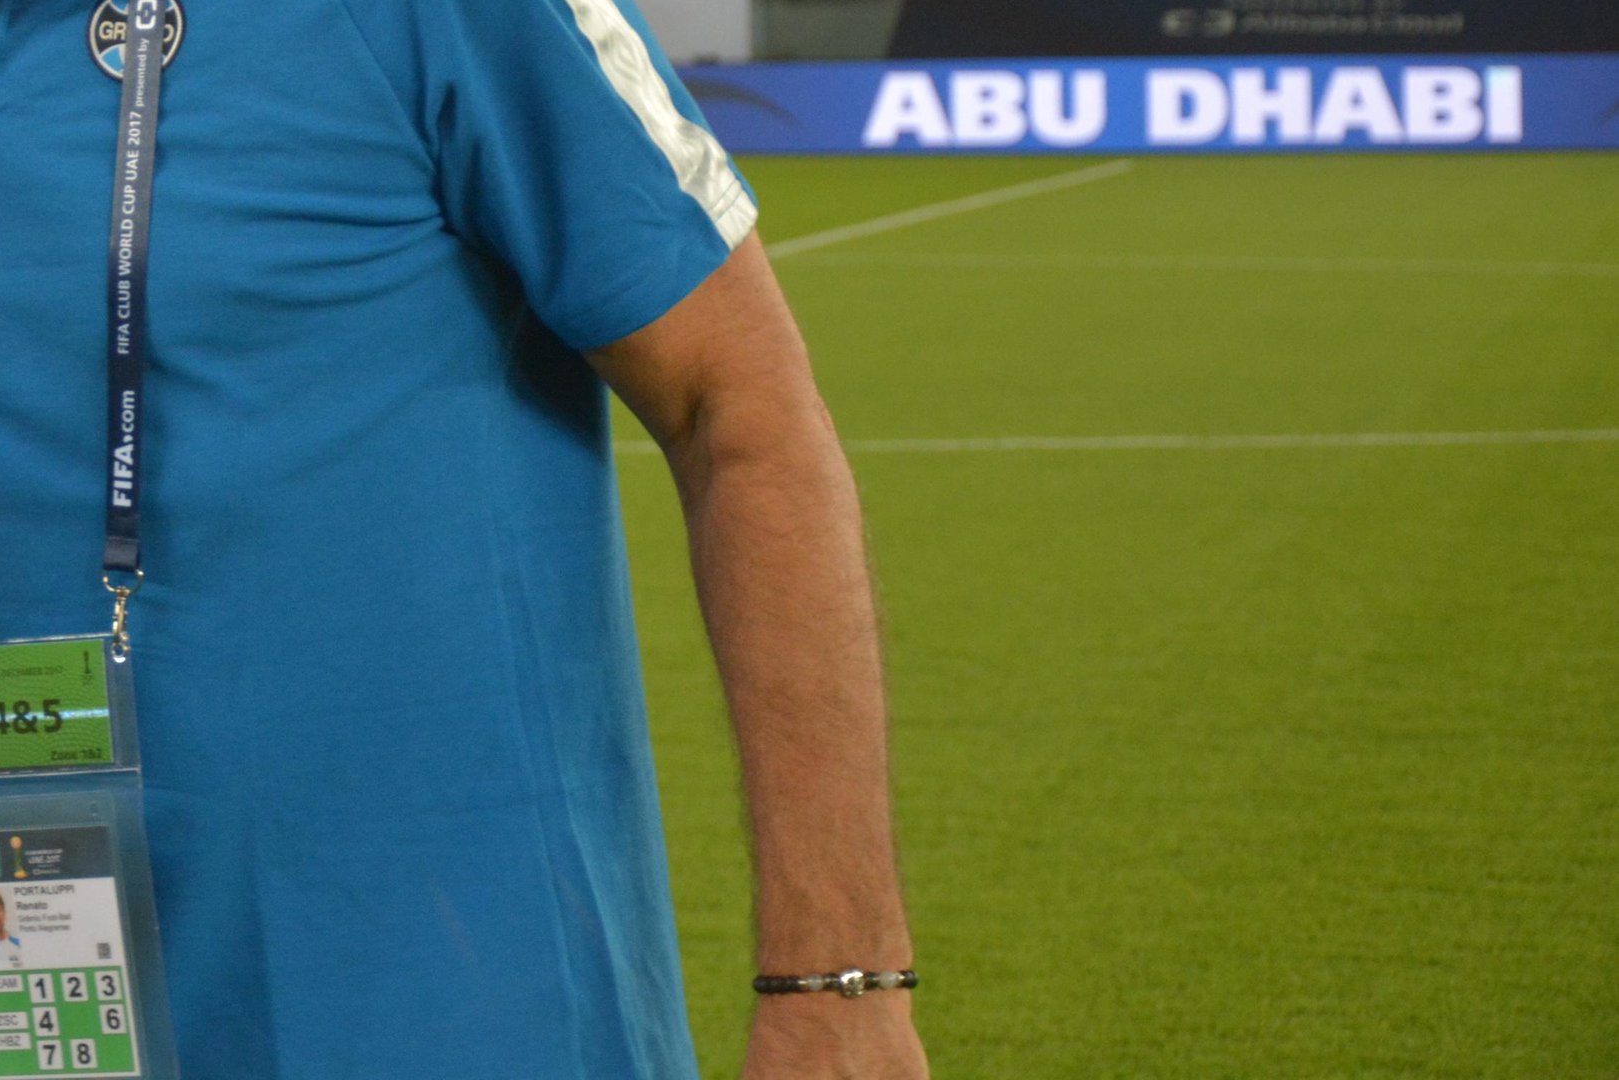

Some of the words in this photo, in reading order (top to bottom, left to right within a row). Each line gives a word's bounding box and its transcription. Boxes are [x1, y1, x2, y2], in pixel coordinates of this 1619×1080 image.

[137, 38, 150, 51] by
[135, 55, 148, 107] presented
[862, 69, 1108, 148] ABU
[1145, 65, 1523, 145] DHABI
[127, 111, 143, 146] 2017
[125, 150, 139, 181] UAE
[122, 184, 137, 215] CUP
[118, 218, 134, 276] WORLD
[117, 279, 131, 319] CLUB
[117, 323, 130, 355] FIFA
[14, 885, 75, 896] PORTALUPPI
[35, 978, 46, 999] 1
[67, 977, 82, 998] 2
[101, 975, 116, 996] 3
[39, 1011, 53, 1032] 4
[106, 1009, 121, 1030] 6
[0, 1035, 21, 1047] HBZ
[43, 1045, 57, 1065] 7
[77, 1043, 91, 1065] 8
